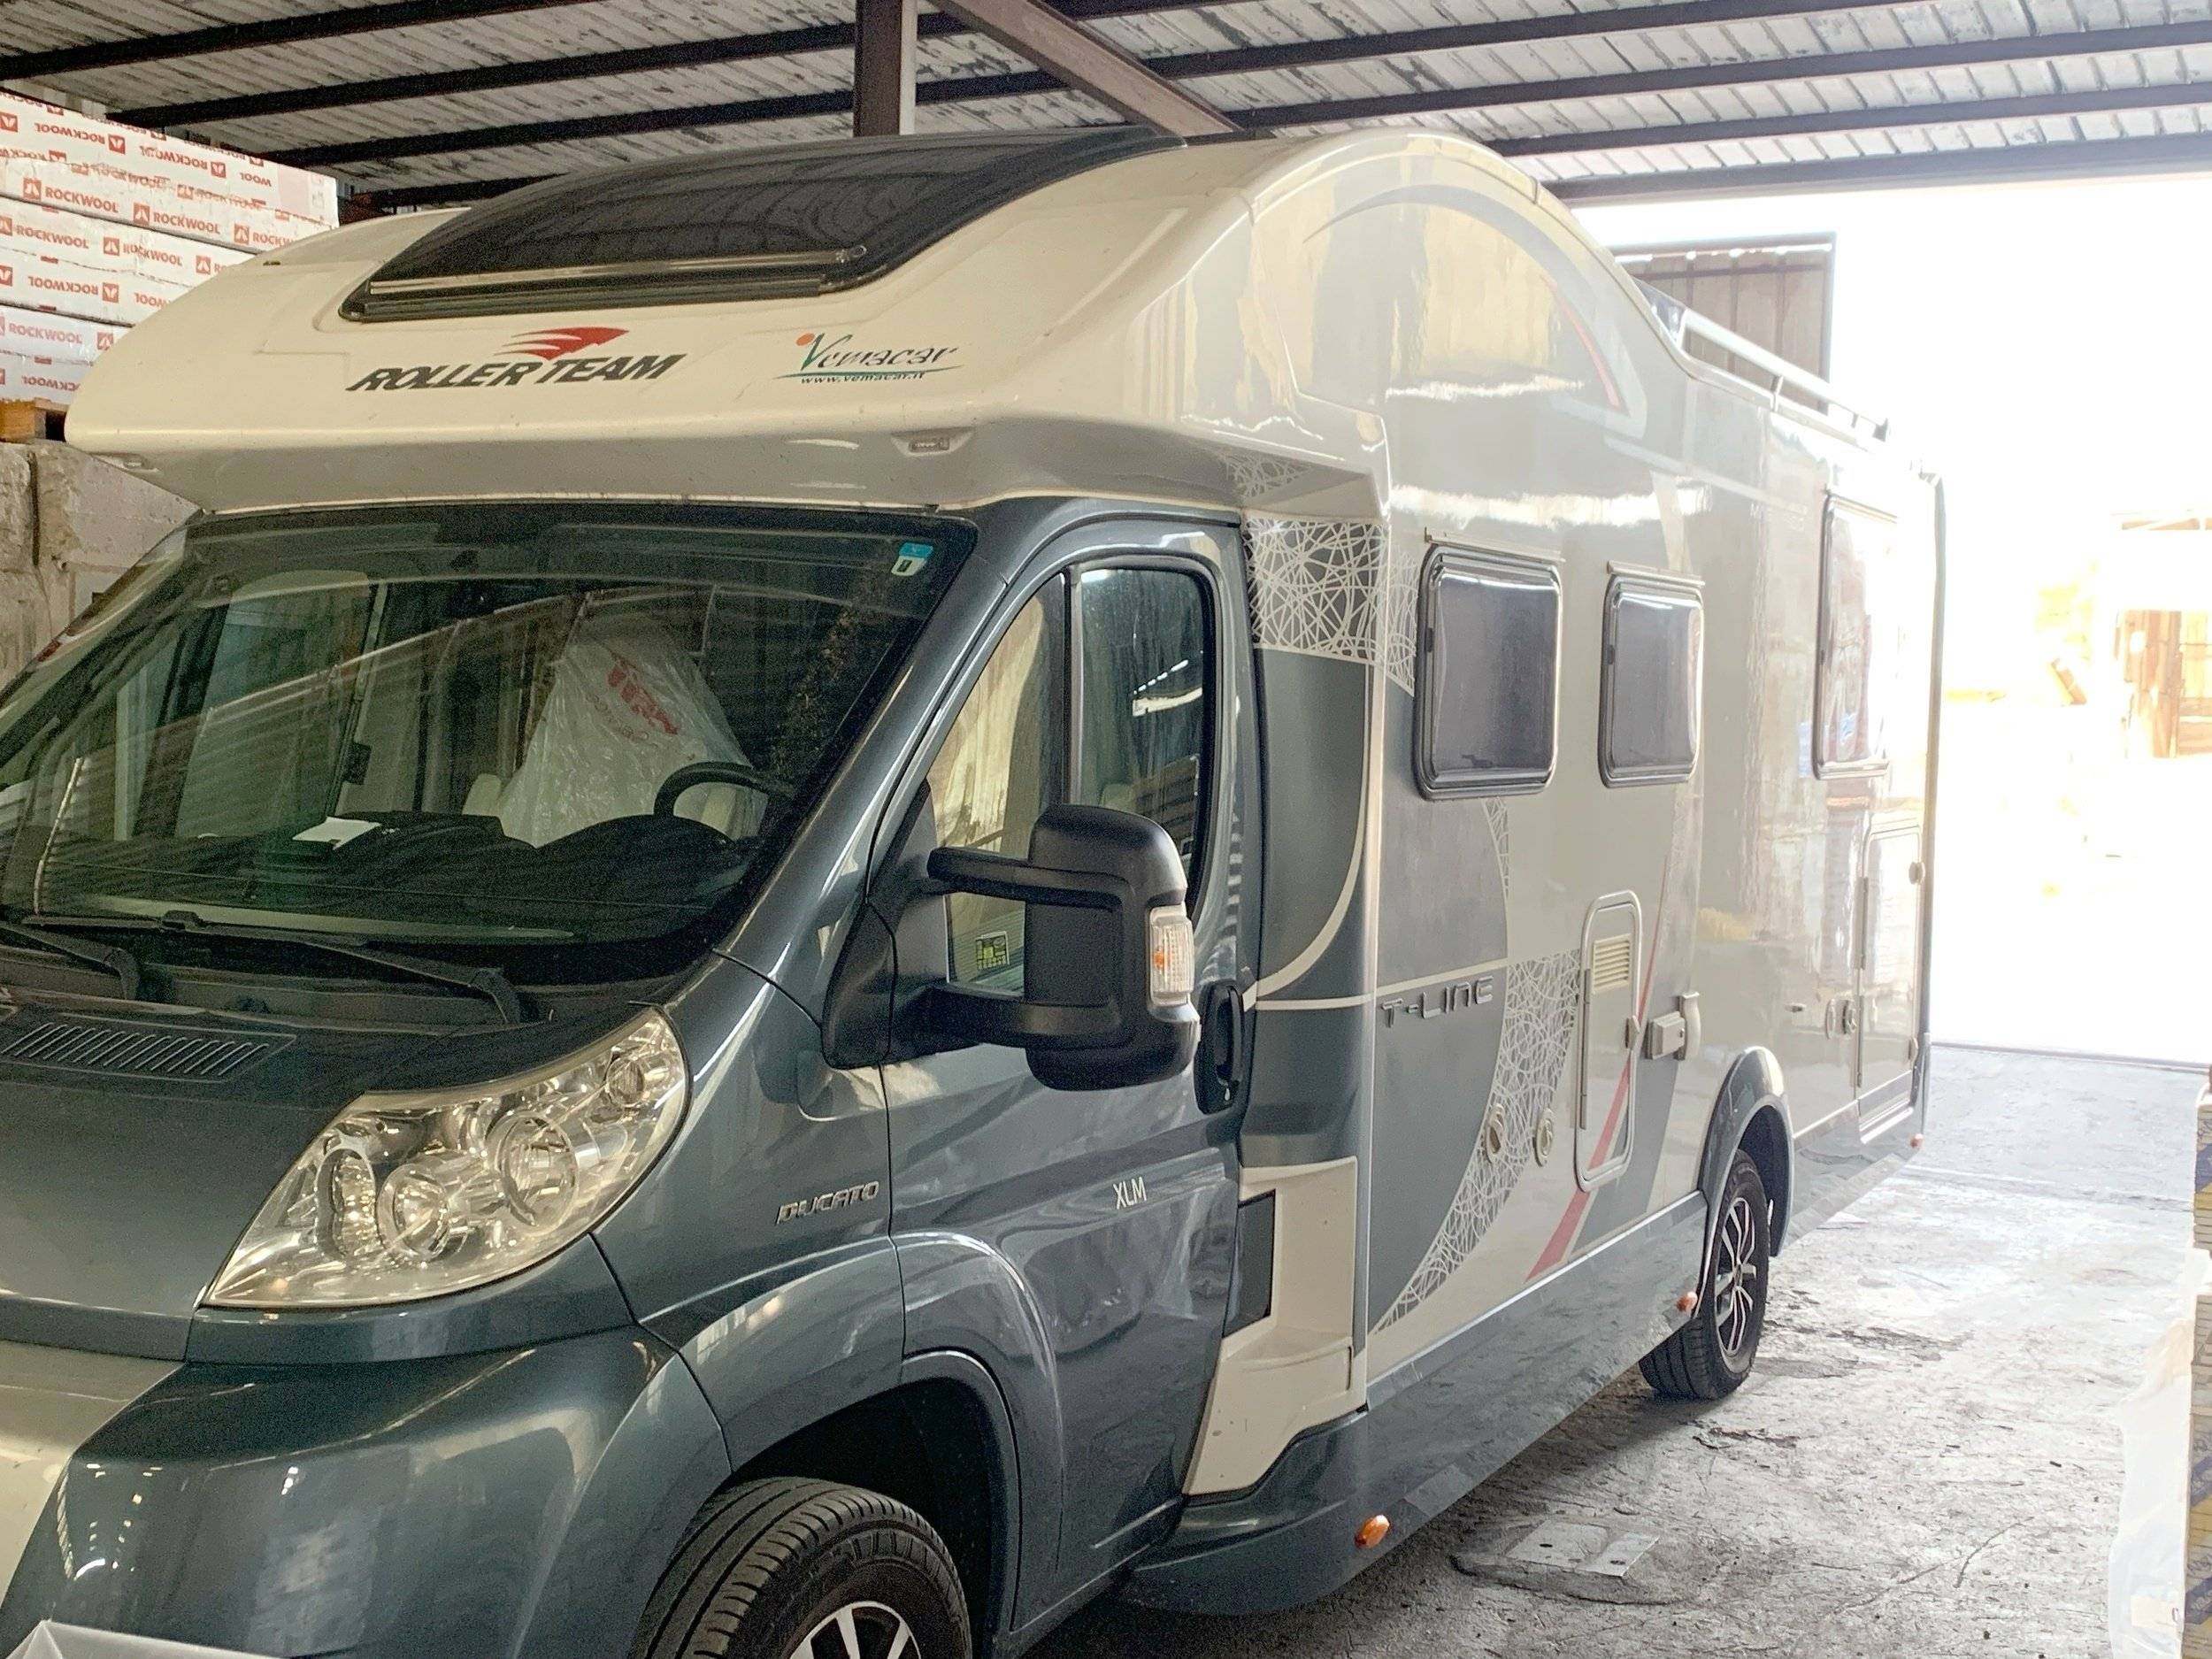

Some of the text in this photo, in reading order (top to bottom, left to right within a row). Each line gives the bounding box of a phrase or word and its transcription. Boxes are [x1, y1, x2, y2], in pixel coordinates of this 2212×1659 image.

[34, 122, 105, 144] ROCKWOOL
[45, 186, 119, 213] ROCKWOOL
[153, 211, 220, 234] ROCKWOOL
[16, 224, 88, 250] ROCKWOOL
[123, 242, 182, 266] ROCKWOOL
[27, 276, 98, 296] ROCKWOOL
[7, 322, 82, 344] ROCKWOOL
[345, 353, 688, 391] ROLLER TEAM
[775, 1180, 880, 1225] DUCATO
[1112, 1176, 1148, 1210] XLM
